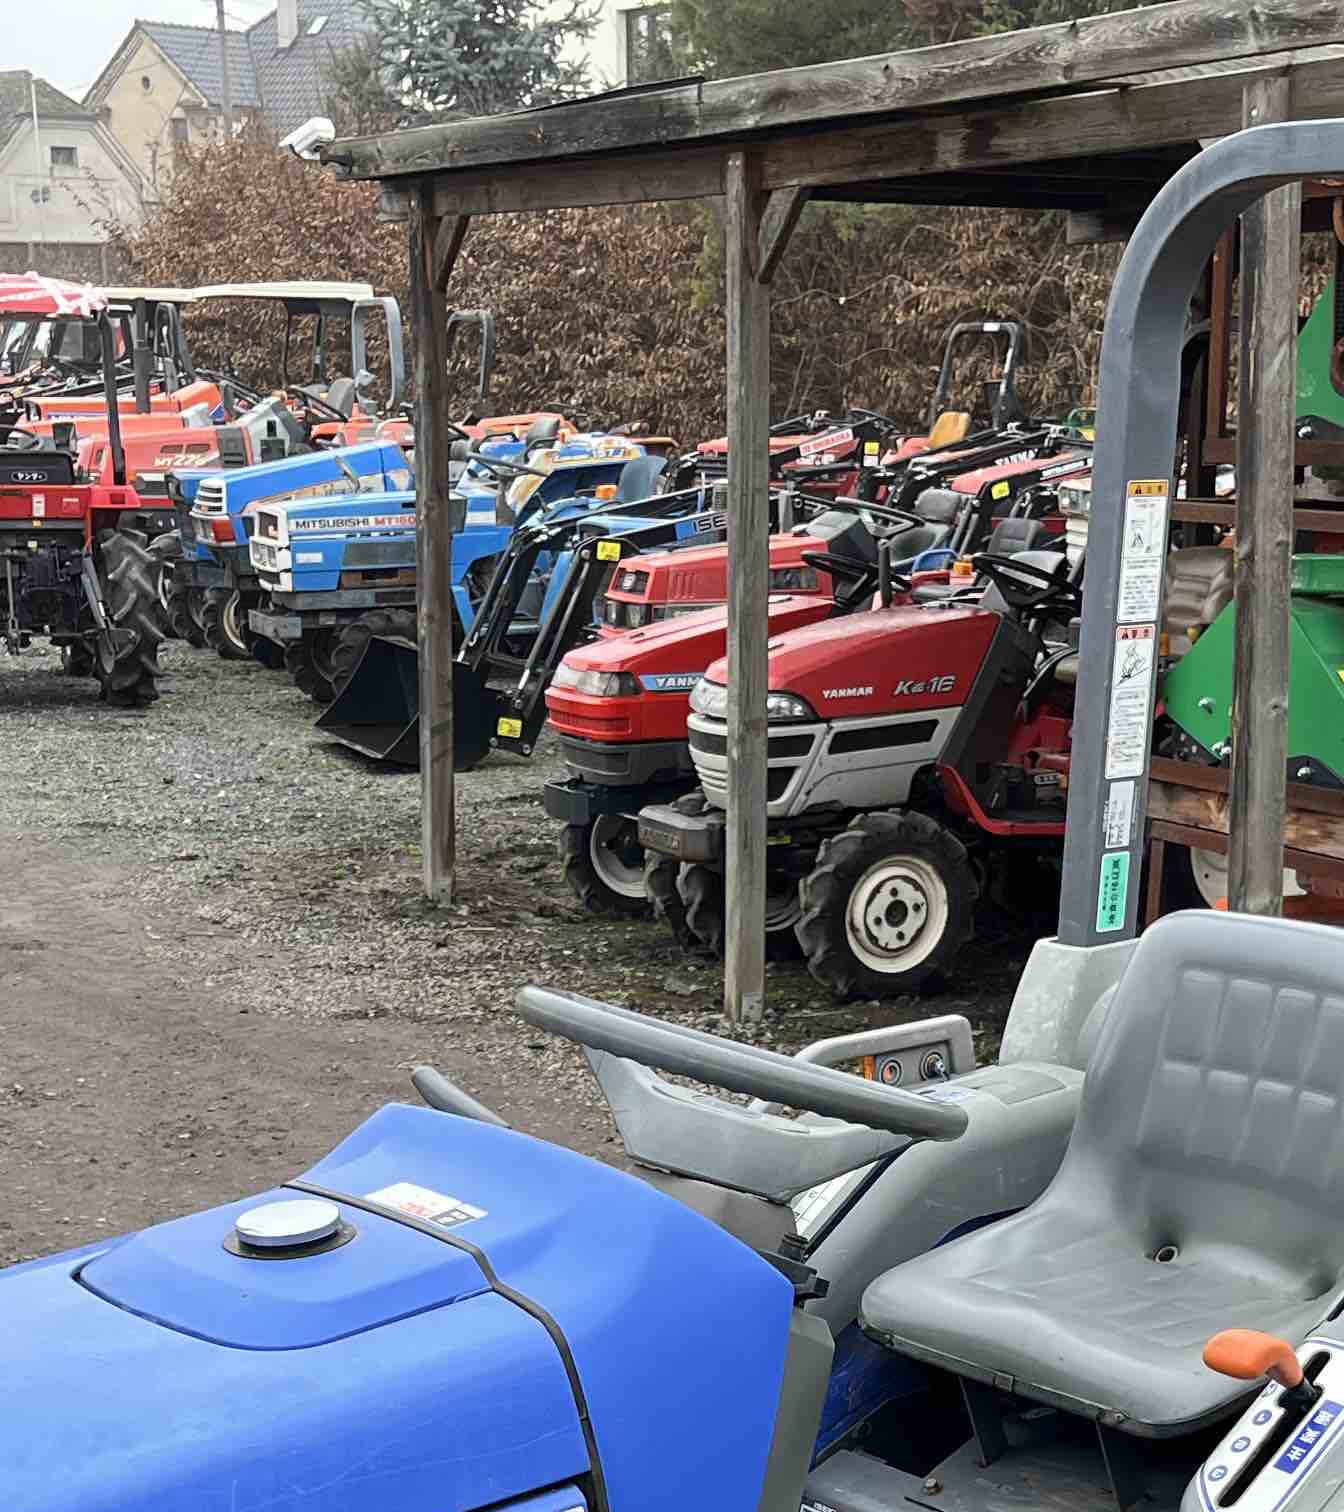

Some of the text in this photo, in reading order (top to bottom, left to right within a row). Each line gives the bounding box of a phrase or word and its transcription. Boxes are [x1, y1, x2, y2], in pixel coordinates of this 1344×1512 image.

[994, 448, 1039, 466] YANMA
[295, 518, 369, 530] MITSUBISHI
[694, 514, 728, 532] ISE
[656, 676, 703, 688] YANM
[822, 686, 873, 699] YANMAR
